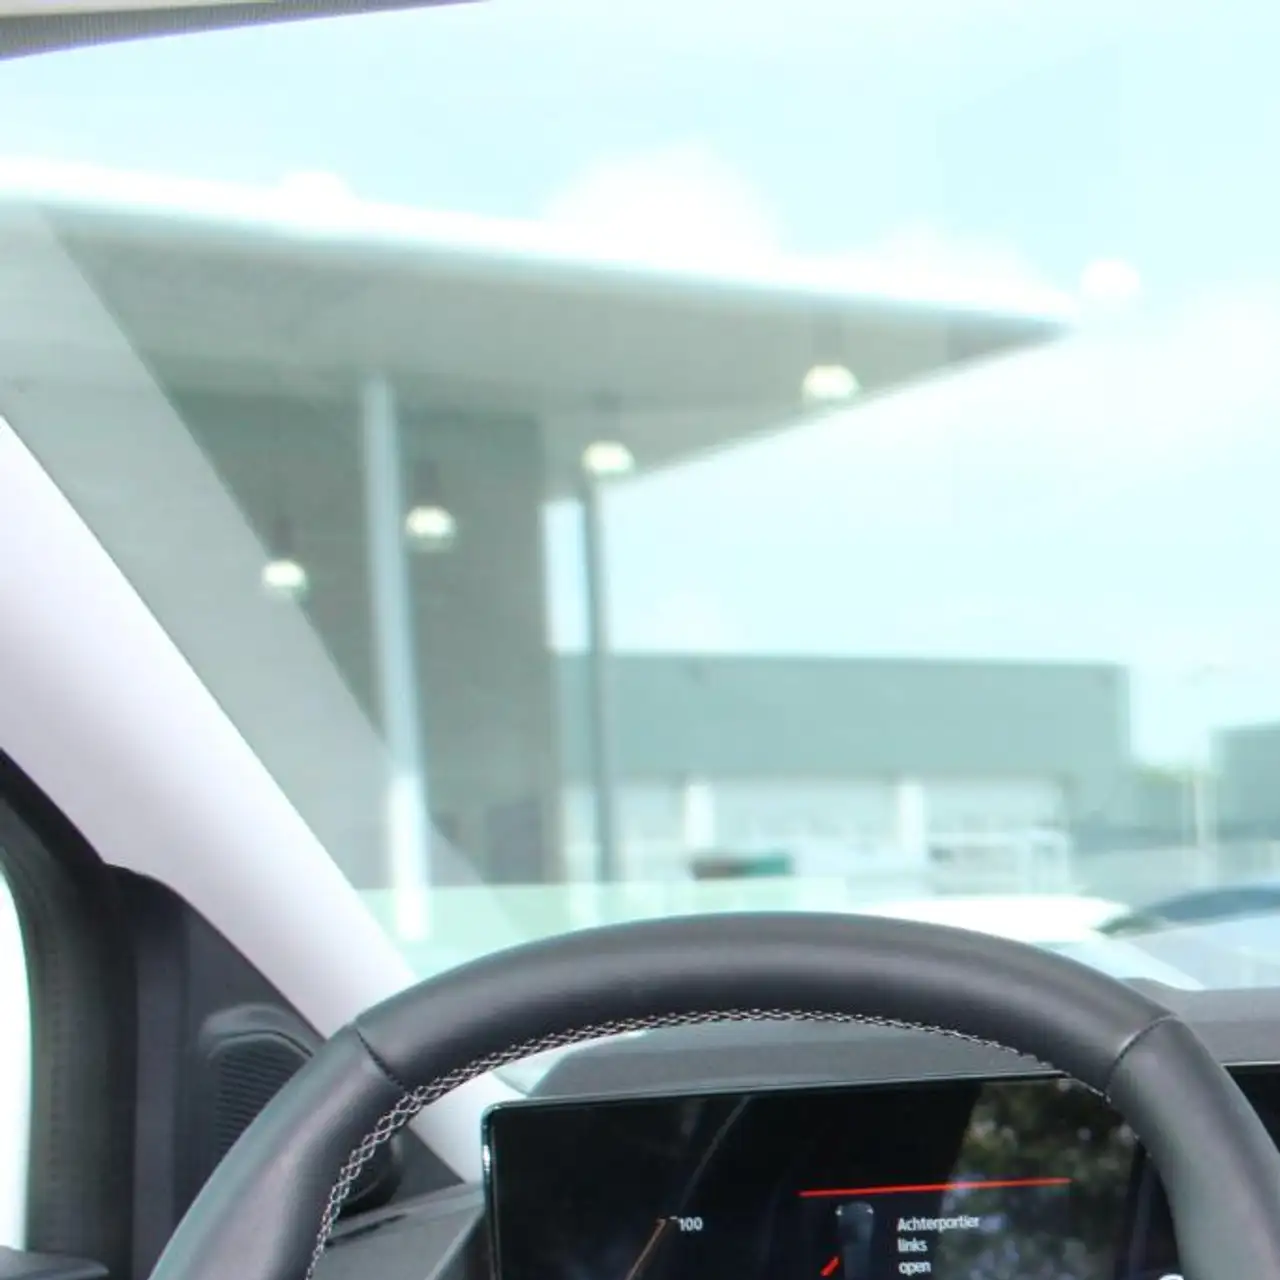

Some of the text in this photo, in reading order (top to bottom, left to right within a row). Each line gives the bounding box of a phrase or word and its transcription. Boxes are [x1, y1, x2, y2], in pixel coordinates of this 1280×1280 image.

[678, 1217, 703, 1231] 100
[897, 1238, 928, 1253] links
[898, 1261, 931, 1276] open
